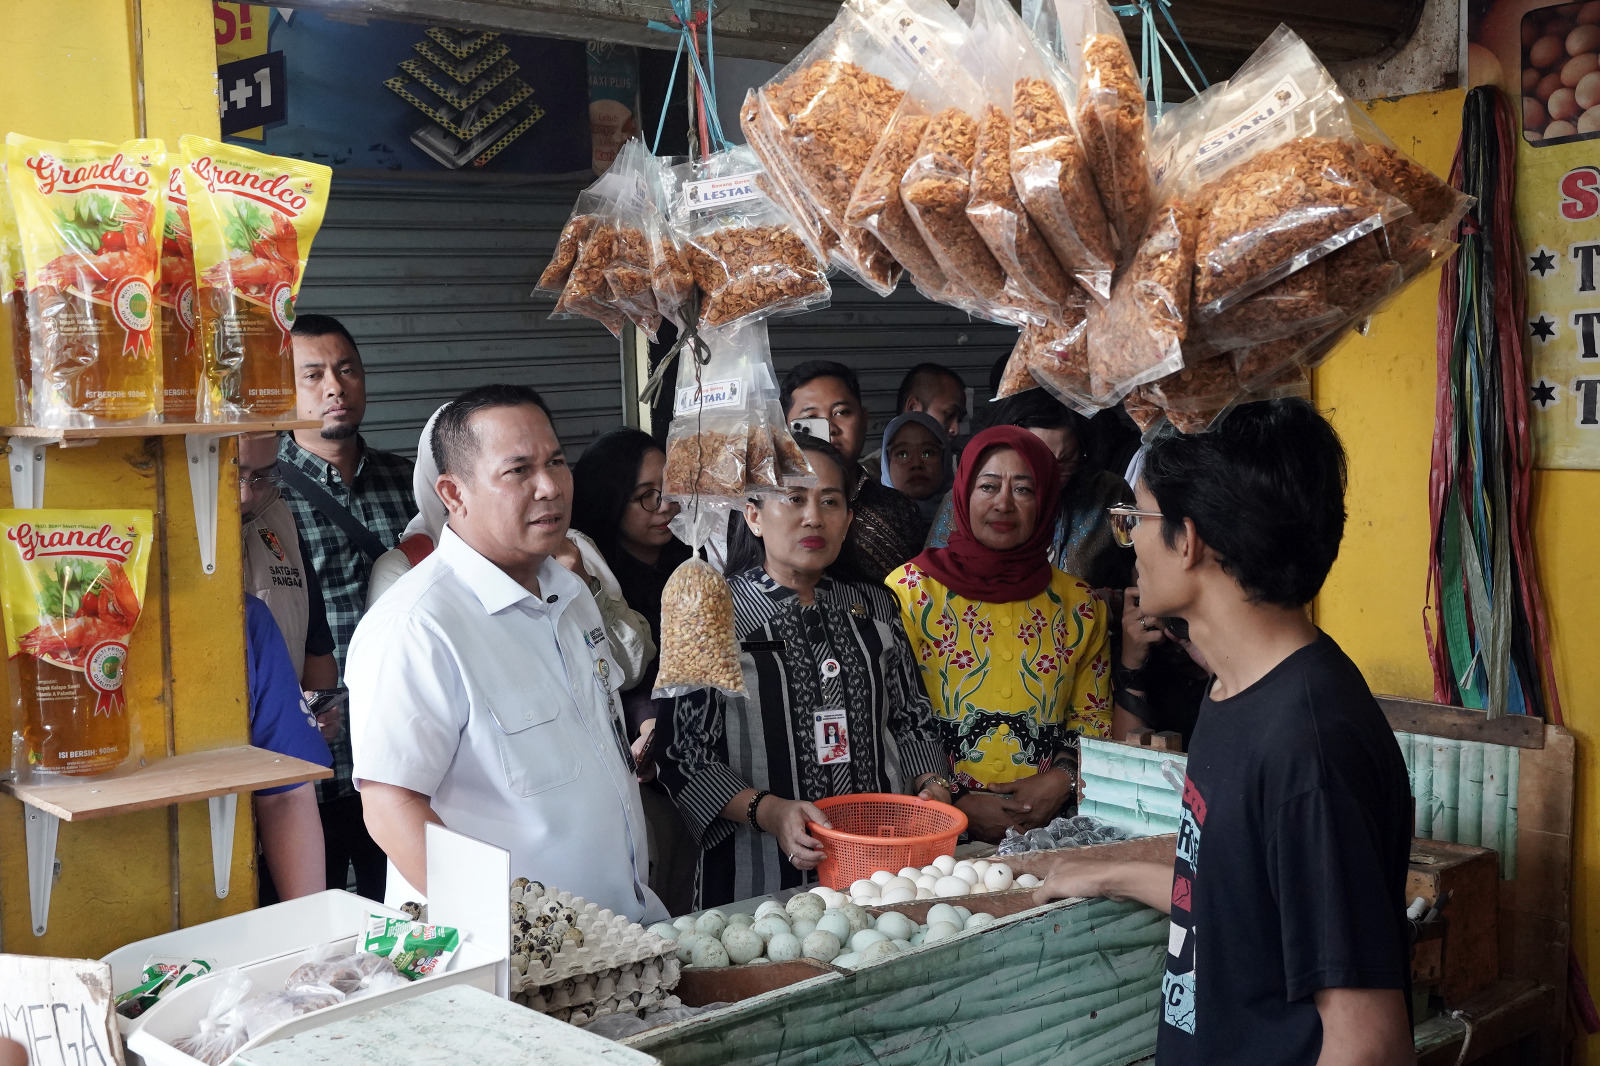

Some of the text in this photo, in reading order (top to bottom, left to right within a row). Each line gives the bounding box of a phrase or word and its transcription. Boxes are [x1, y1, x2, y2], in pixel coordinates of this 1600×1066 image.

[1198, 108, 1275, 155] ESTARI
[26, 153, 149, 195] Grandco
[191, 156, 307, 210] Grandco
[703, 186, 753, 200] LESTAR
[7, 523, 134, 561] Grandco
[69, 749, 98, 758] BERSIH:
[0, 1002, 108, 1066] MEGA
